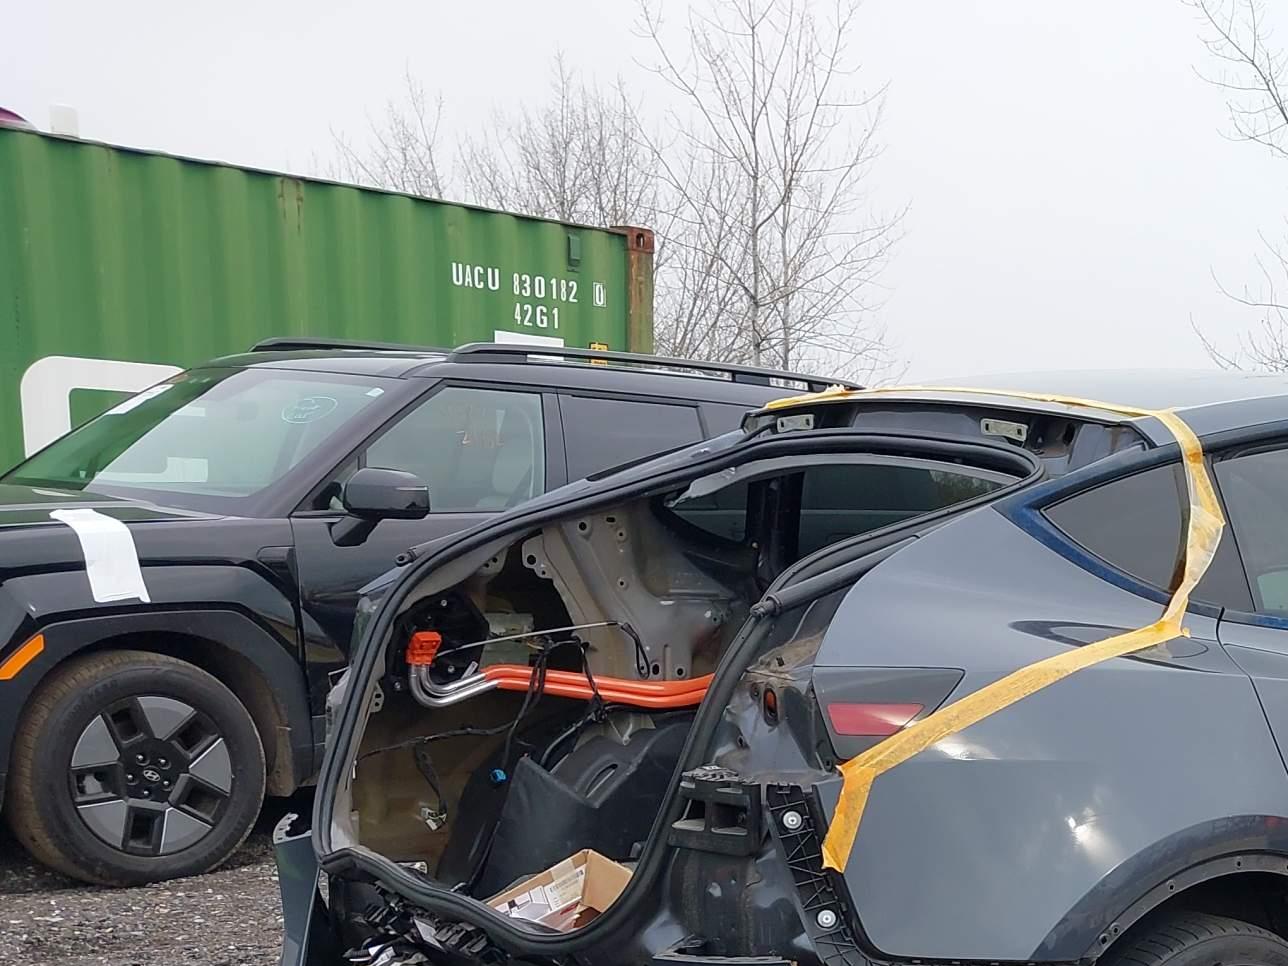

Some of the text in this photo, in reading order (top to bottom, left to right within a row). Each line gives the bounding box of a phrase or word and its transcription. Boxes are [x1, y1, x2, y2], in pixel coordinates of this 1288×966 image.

[452, 262, 606, 306] UACU 830182 0
[514, 302, 560, 329] 42G1
